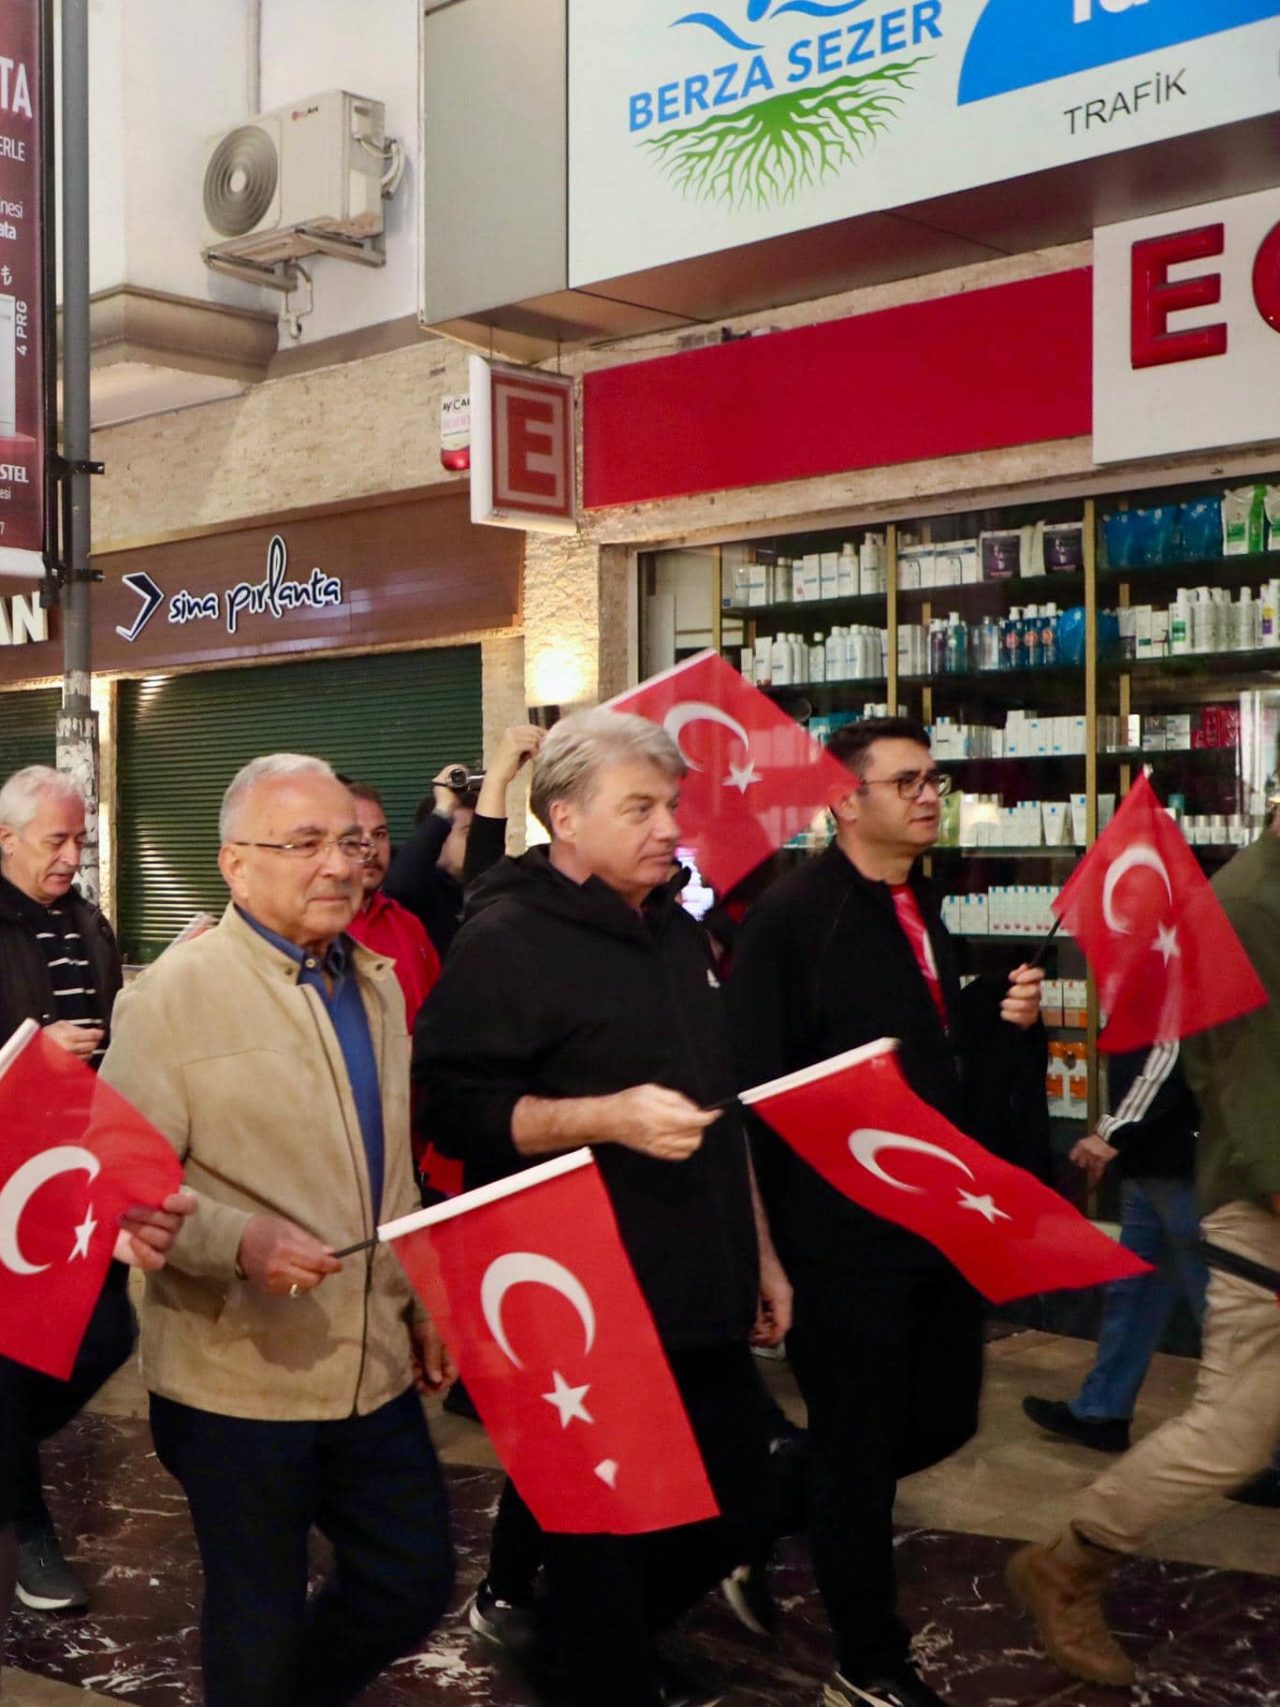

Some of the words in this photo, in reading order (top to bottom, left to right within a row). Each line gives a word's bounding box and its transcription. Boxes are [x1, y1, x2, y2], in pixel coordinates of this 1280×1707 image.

[628, 49, 775, 132] BERZA
[786, 1, 943, 83] SEZER
[1063, 68, 1187, 135] TRAFİK
[16, 301, 28, 340] PRG
[1131, 218, 1280, 370] E
[16, 344, 28, 356] 4
[507, 395, 557, 497] E
[168, 589, 219, 623] sina
[225, 534, 343, 634] pırlanta
